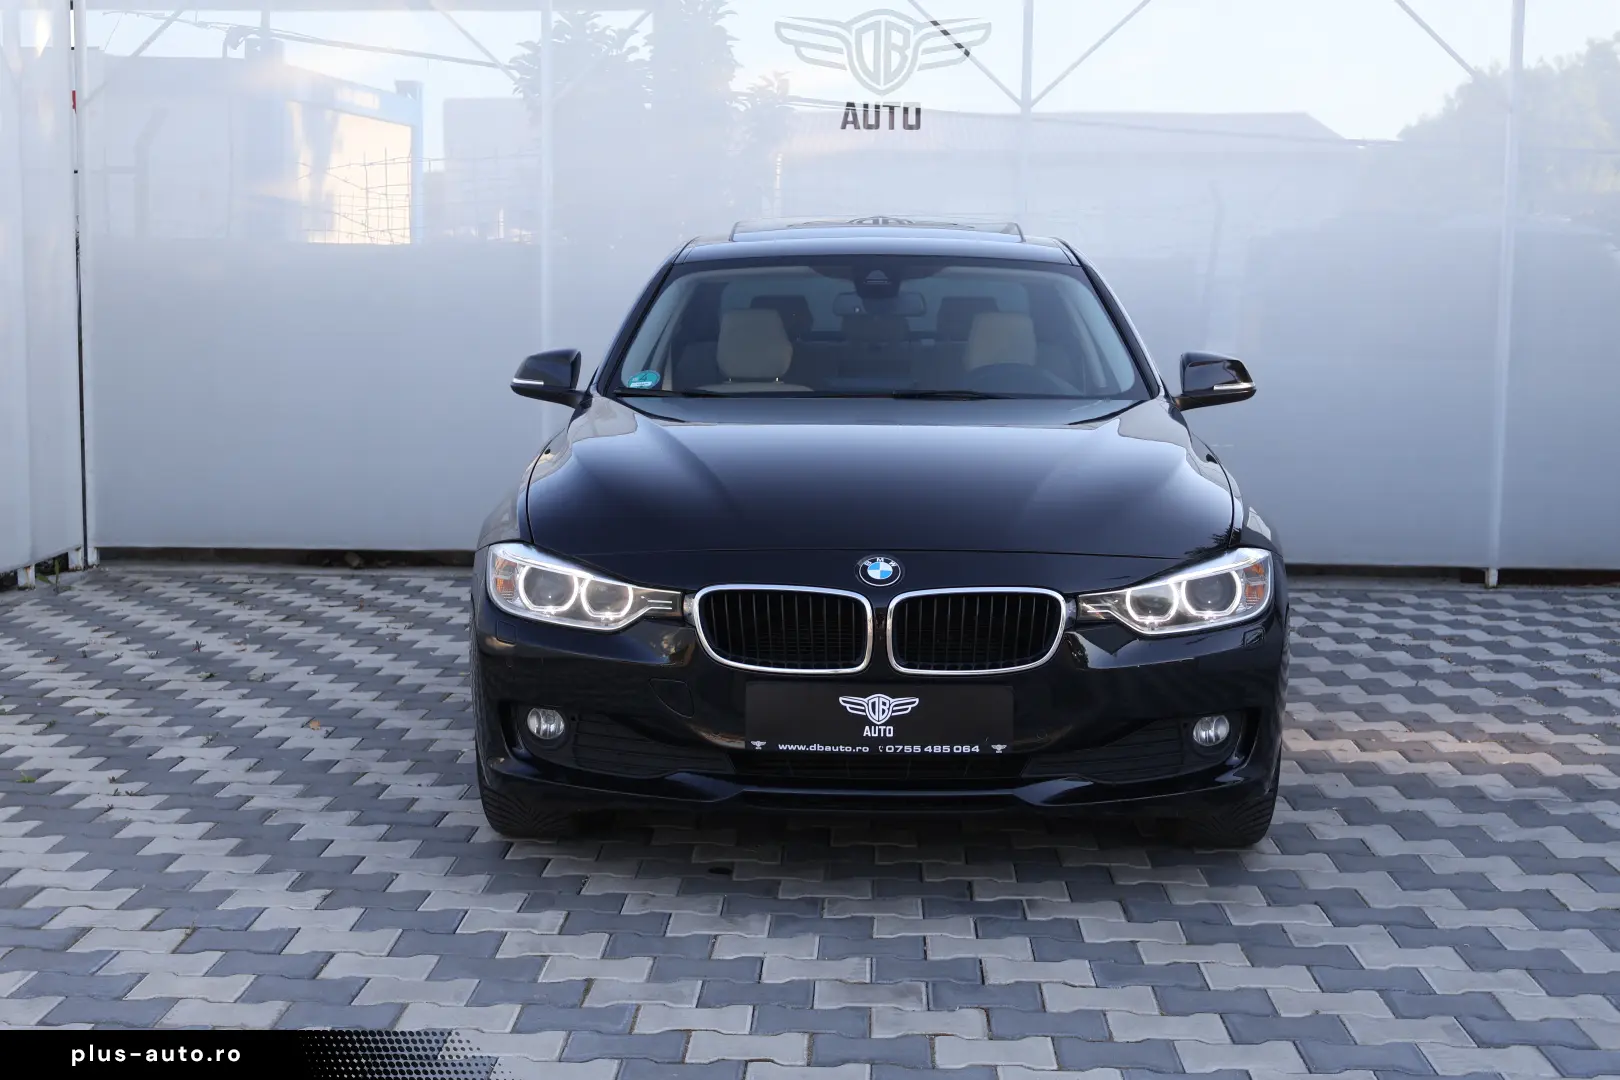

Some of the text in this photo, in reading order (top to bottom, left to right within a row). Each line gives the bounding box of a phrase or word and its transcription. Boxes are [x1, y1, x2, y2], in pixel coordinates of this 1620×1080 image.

[840, 101, 922, 131] AUTO
[863, 557, 898, 567] BMW
[863, 725, 894, 737] AUTO
[778, 743, 980, 753] www.dbauto.ro 0755 485 064
